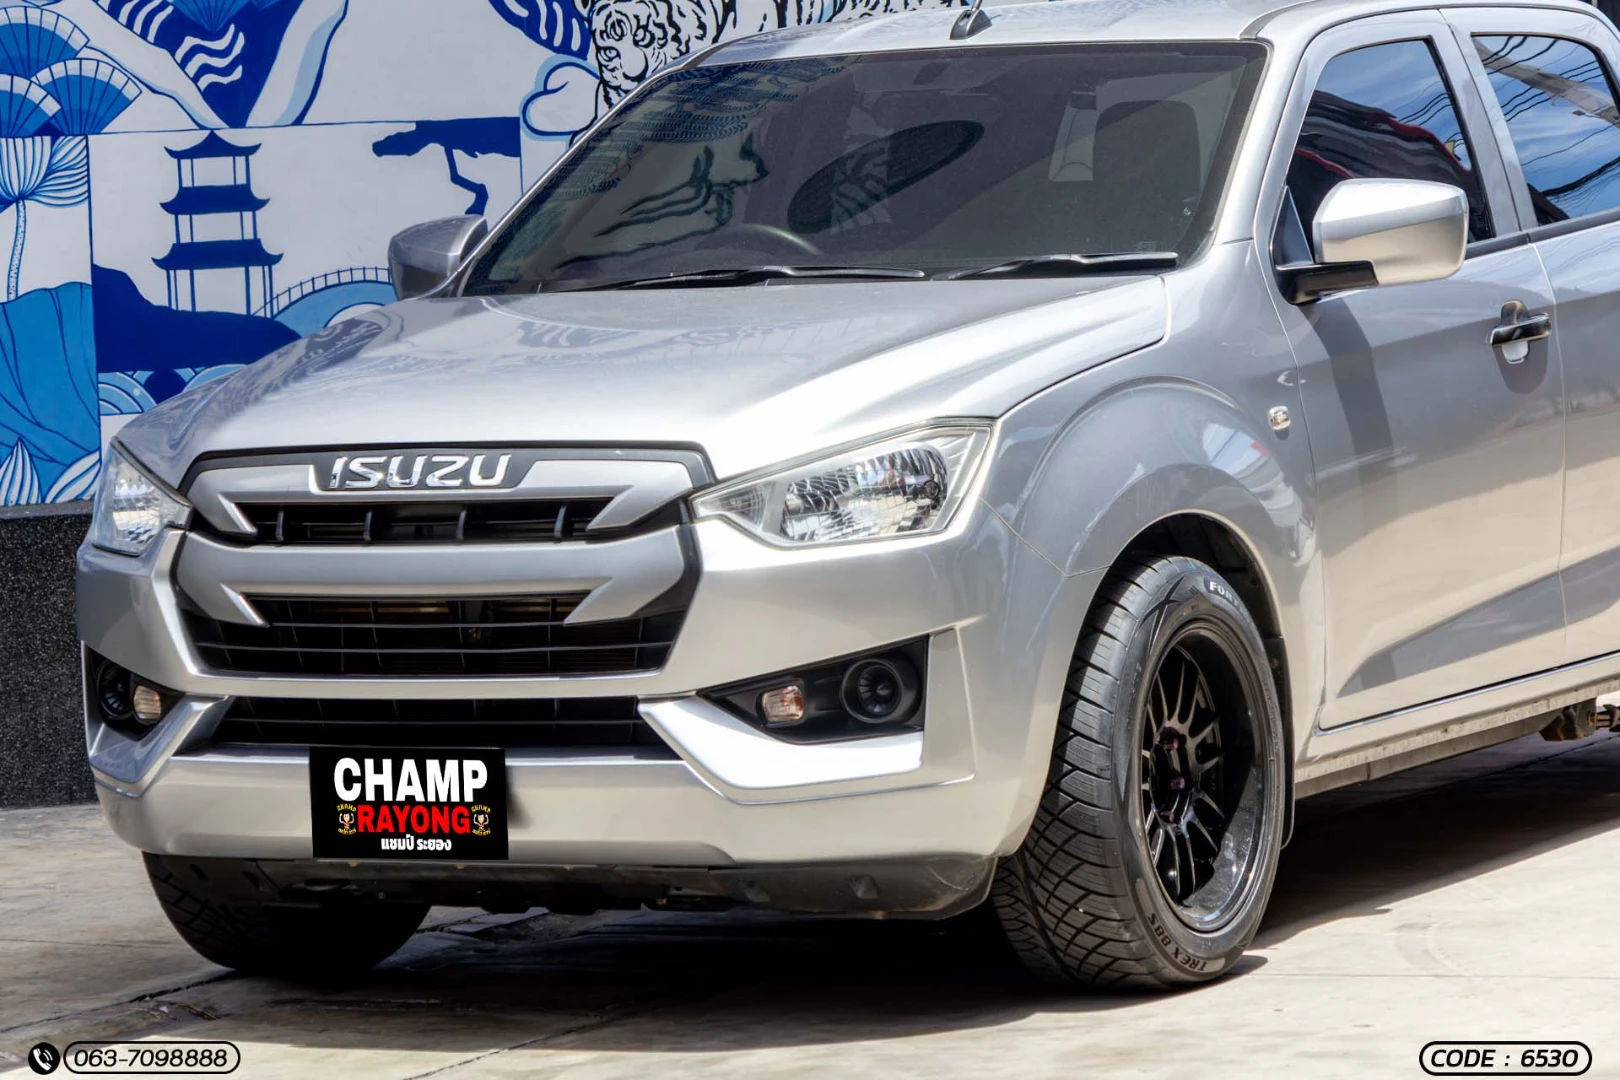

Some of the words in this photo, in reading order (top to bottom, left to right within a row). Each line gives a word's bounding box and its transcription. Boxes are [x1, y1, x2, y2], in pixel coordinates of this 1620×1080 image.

[328, 453, 512, 489] ISUZU
[334, 757, 488, 803] CHAMP
[357, 804, 471, 834] RAYONG
[416, 838, 452, 851] ระยอง
[1171, 948, 1208, 972] TREX
